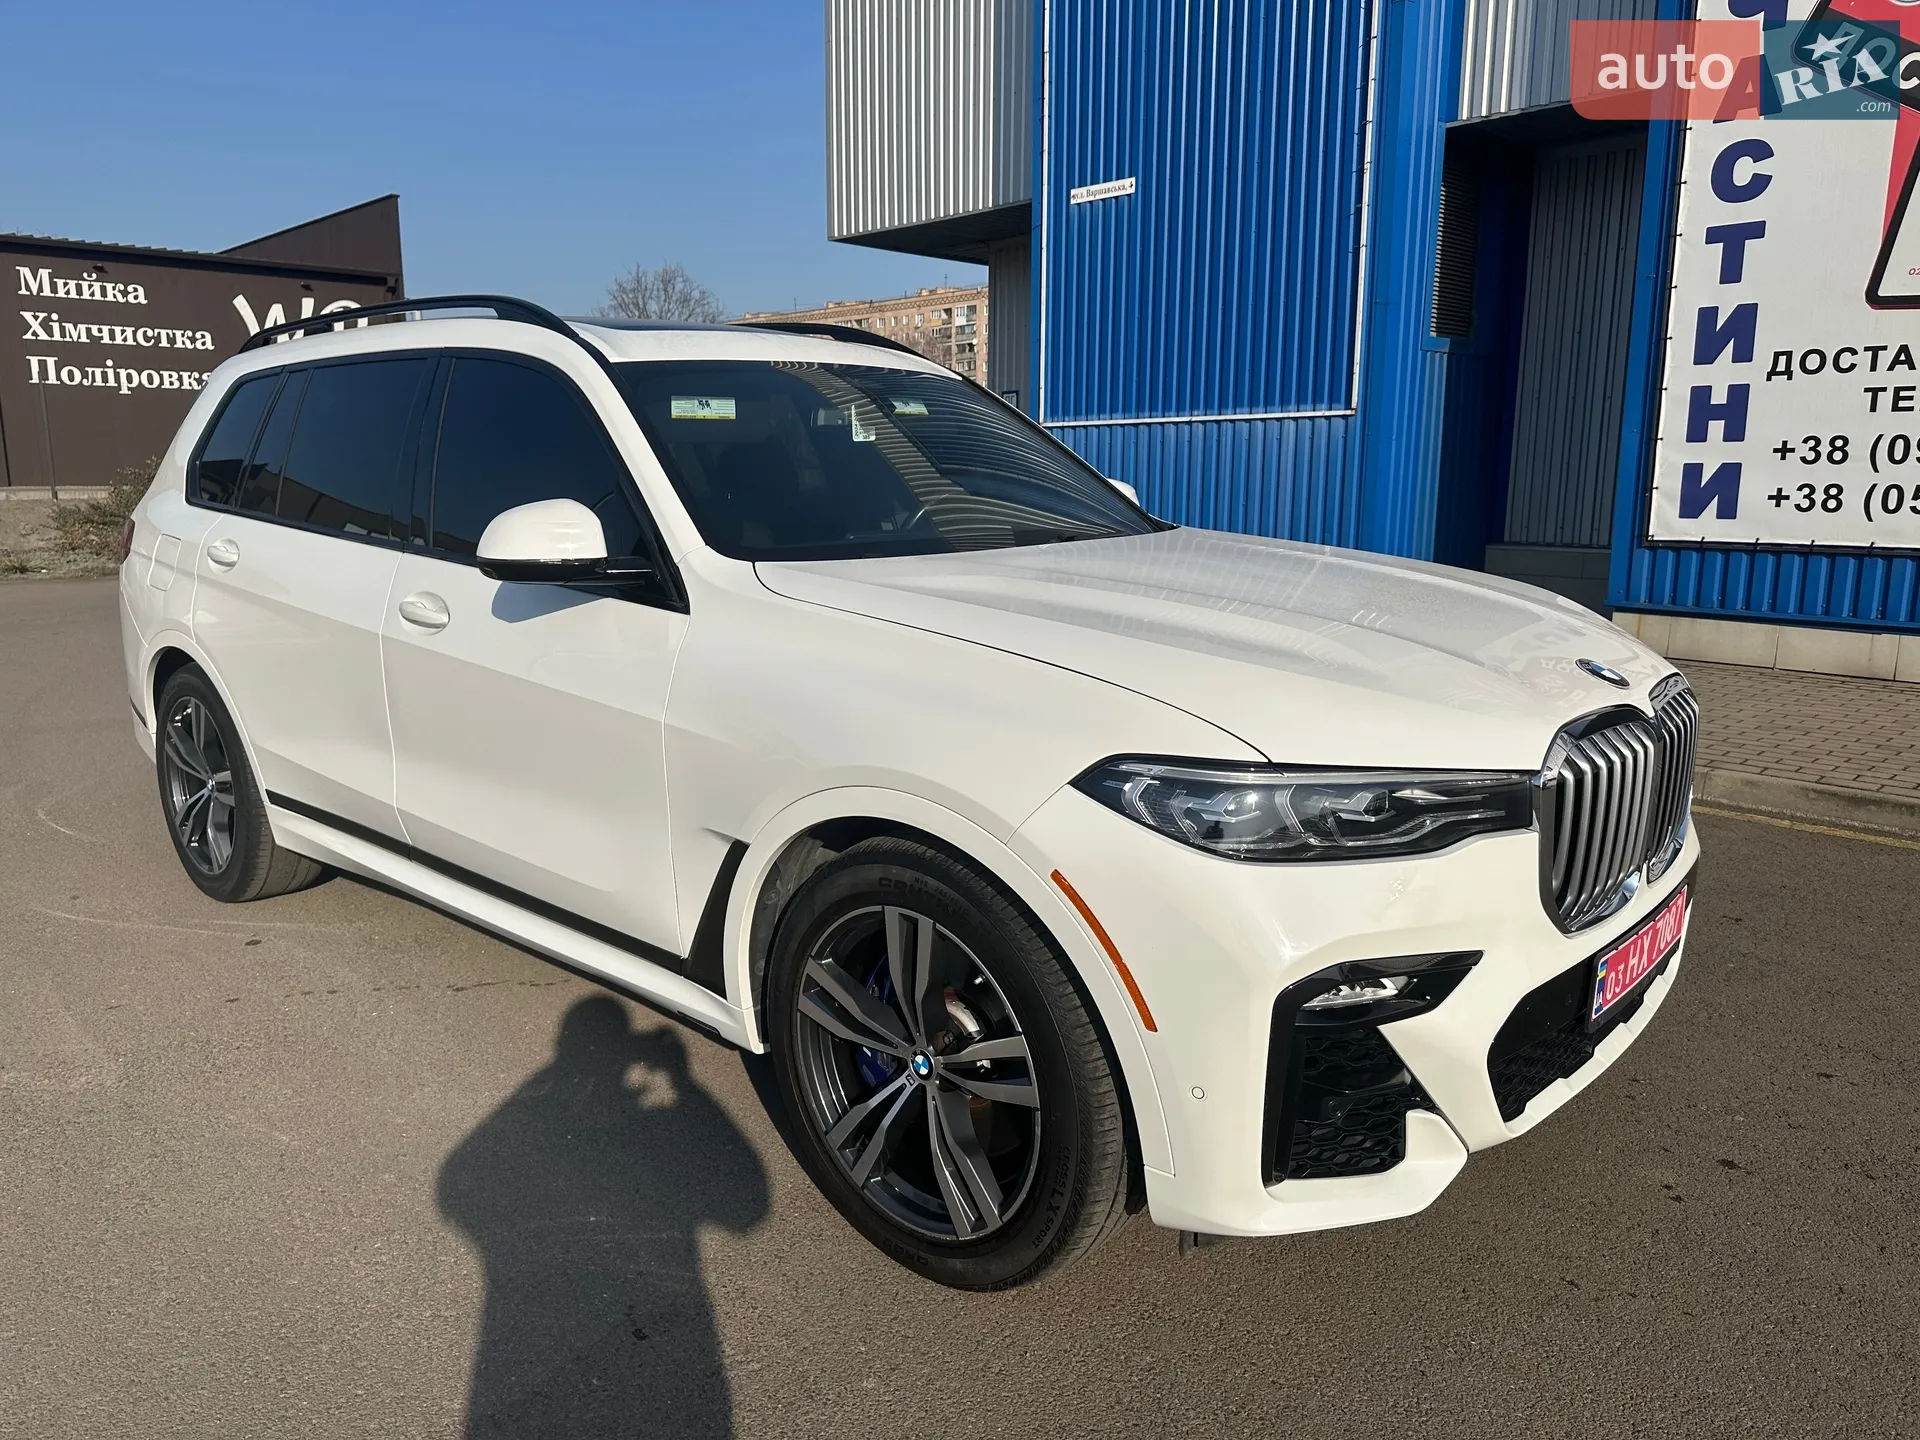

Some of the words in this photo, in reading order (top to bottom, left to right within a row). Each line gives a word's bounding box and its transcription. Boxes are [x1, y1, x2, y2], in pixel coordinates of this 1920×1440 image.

[16, 266, 148, 304] Мийка
[20, 311, 215, 350] Хімчистка
[1766, 344, 1917, 381] ДОСТА
[1863, 385, 1920, 413] ТЕ
[1772, 435, 1850, 465] +38
[1869, 434, 1920, 473] (0
[1767, 483, 1844, 513] +38
[1606, 965, 1623, 1000] 03
[1626, 931, 1652, 983] HX
